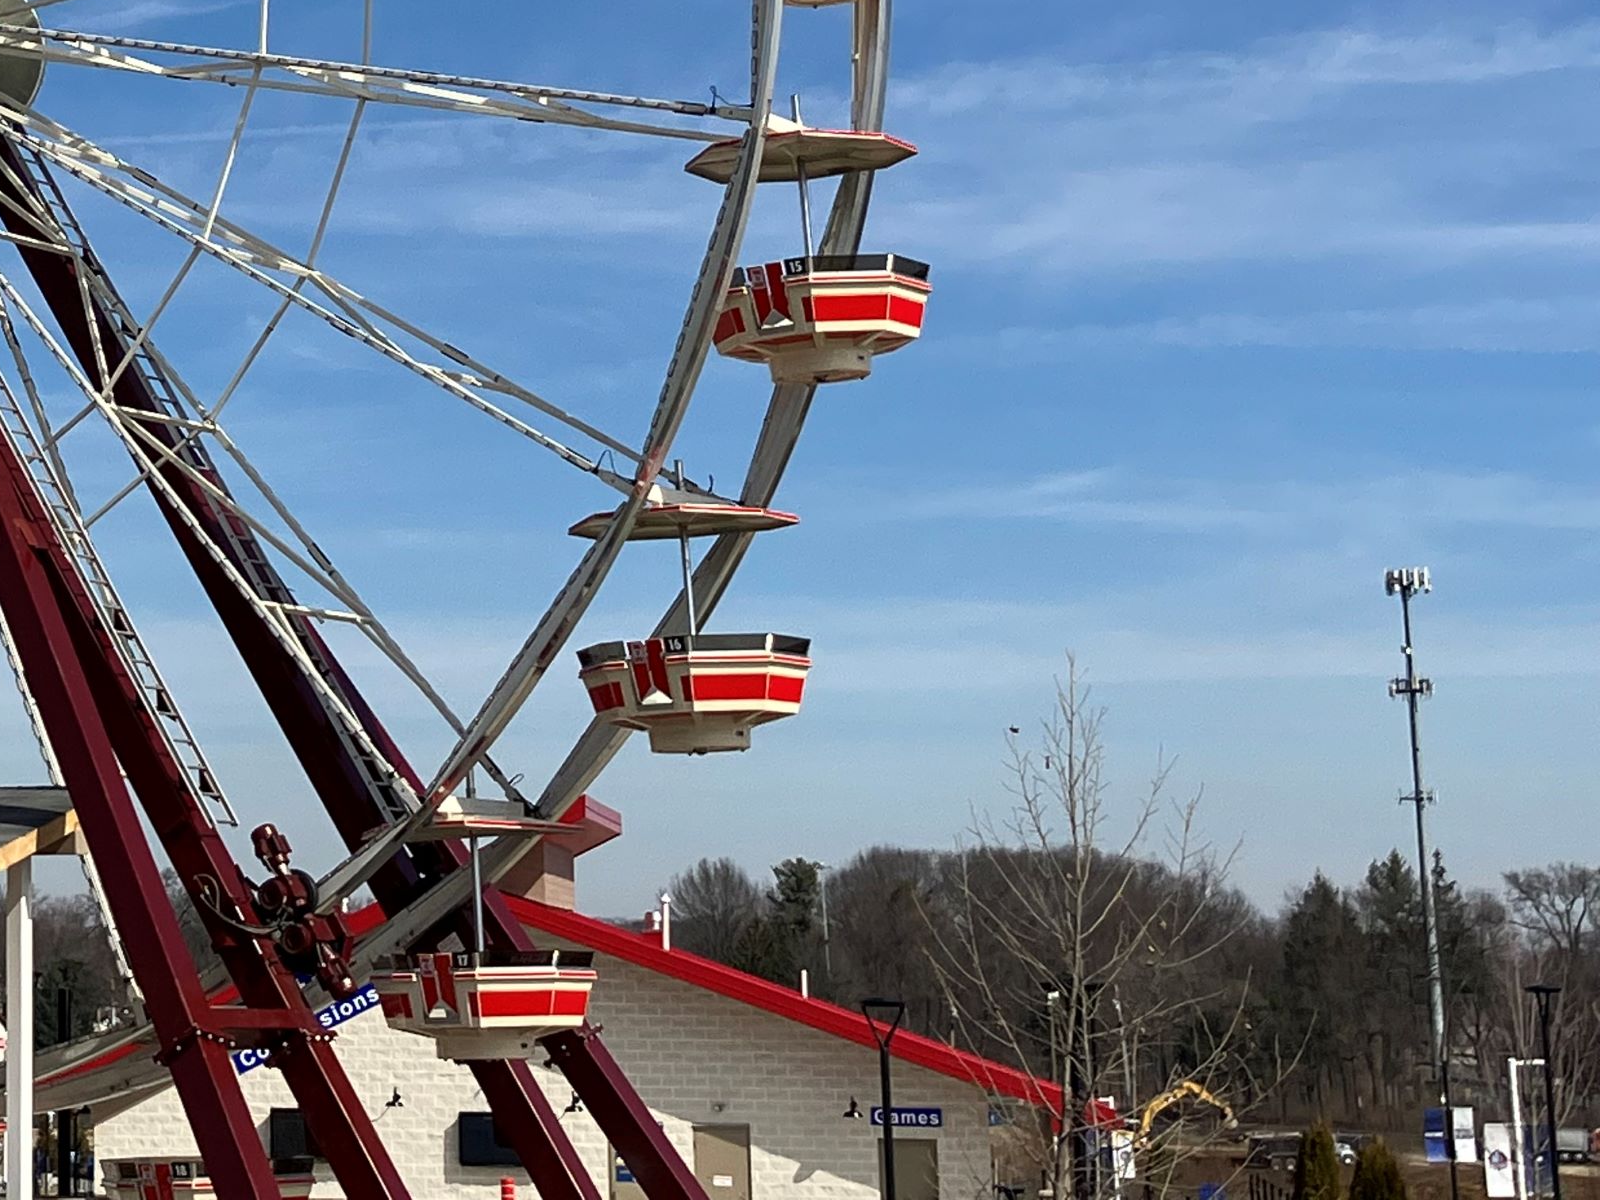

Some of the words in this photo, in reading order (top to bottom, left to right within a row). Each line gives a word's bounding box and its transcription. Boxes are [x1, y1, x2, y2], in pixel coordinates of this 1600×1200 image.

[789, 260, 802, 273] 15
[668, 638, 682, 651] 16
[457, 954, 468, 966] 17
[174, 1164, 188, 1176] 18
